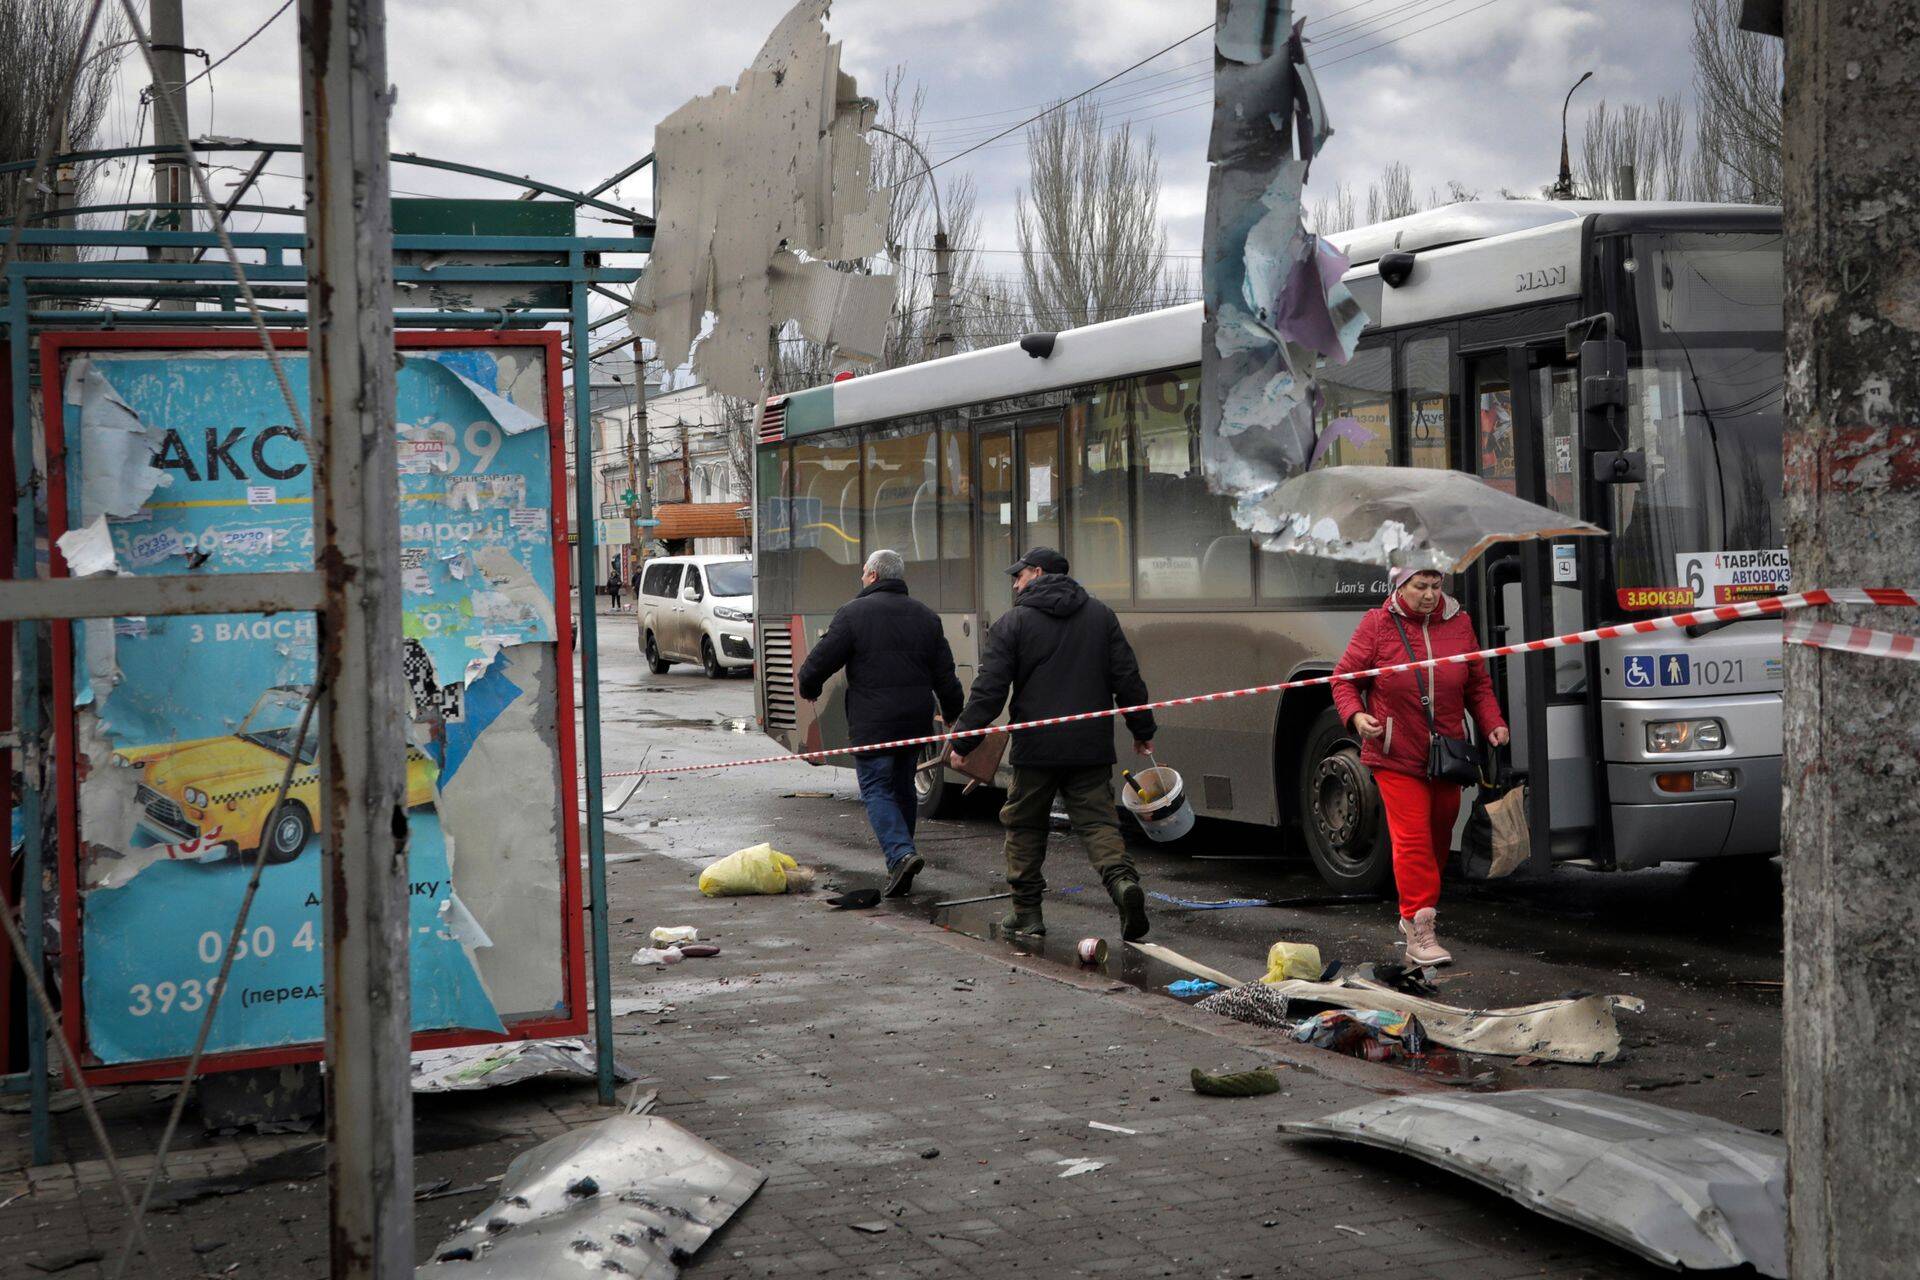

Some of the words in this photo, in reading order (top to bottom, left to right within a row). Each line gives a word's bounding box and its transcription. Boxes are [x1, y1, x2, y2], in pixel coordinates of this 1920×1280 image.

[1514, 265, 1566, 293] MAN
[151, 425, 309, 482] АКС
[1723, 549, 1789, 569] ТАВРІЙСЬ
[1686, 559, 1705, 599] 6
[1732, 568, 1791, 584] АВТОВОКЗ
[1335, 581, 1365, 594] Lion's
[1370, 580, 1395, 597] City
[1627, 590, 1694, 607] З.ВОКЗАЛ
[215, 618, 313, 641] власн
[1693, 659, 1744, 686] 1021
